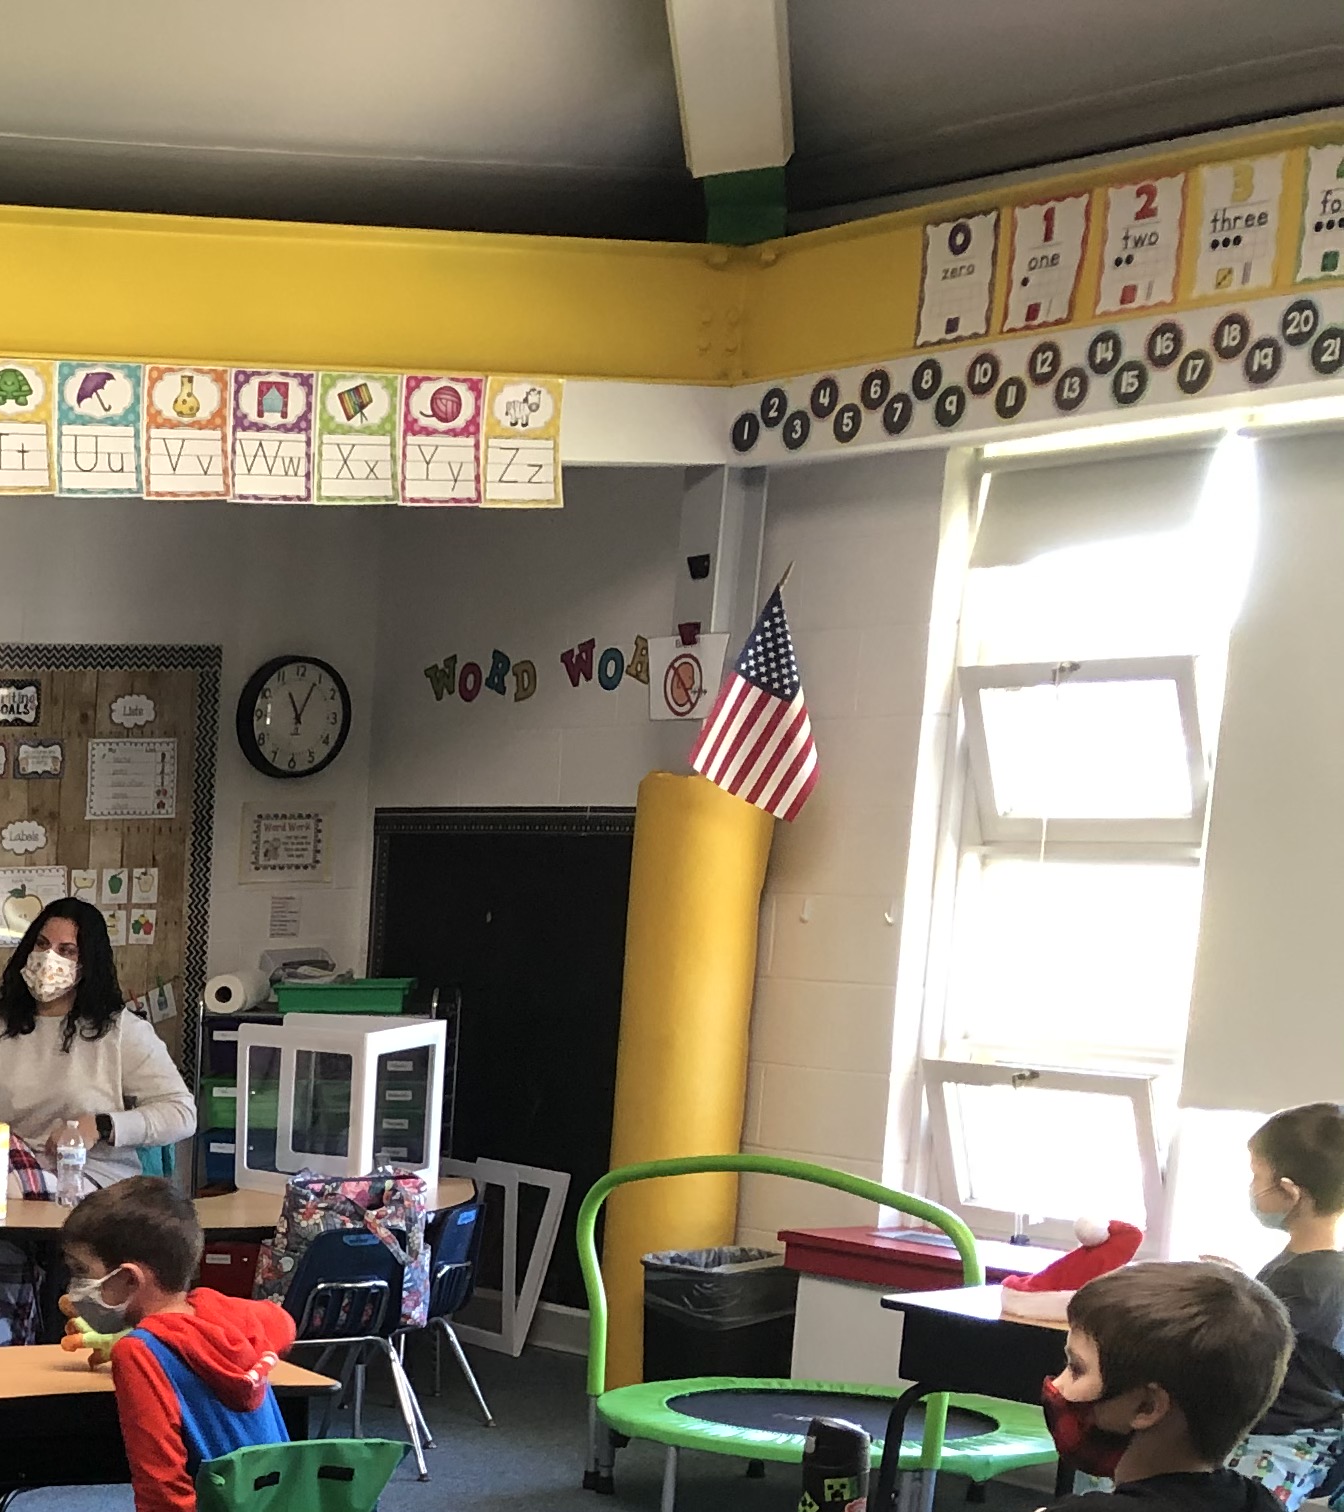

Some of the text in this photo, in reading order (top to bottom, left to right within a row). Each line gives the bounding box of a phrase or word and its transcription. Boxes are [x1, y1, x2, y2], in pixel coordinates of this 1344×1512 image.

[1231, 169, 1255, 201] 3
[1133, 184, 1160, 222] 2
[1321, 189, 1343, 215] fo
[1041, 207, 1057, 244] 1
[1211, 207, 1269, 231] three
[1121, 226, 1160, 251] two
[1027, 249, 1060, 271] one
[941, 262, 975, 281] zero
[1288, 309, 1312, 332] 20
[1155, 334, 1173, 355] 16
[1223, 325, 1241, 346] 18
[1036, 352, 1052, 372] 12
[920, 369, 932, 389] 8
[974, 363, 992, 384] 10
[818, 386, 831, 407] 4
[870, 379, 881, 400] 6
[768, 397, 779, 415] 2
[73, 435, 124, 473] Uu
[163, 438, 213, 475] Vv
[238, 440, 301, 477] Ww
[336, 444, 379, 479] Xx
[417, 444, 463, 492] Yy
[498, 447, 543, 484] Zz
[296, 665, 307, 677] 12
[424, 635, 649, 702] WORD WOR
[329, 688, 336, 700] 2
[123, 706, 144, 717] Lists
[331, 712, 338, 725] 3
[9, 831, 39, 843] Labels
